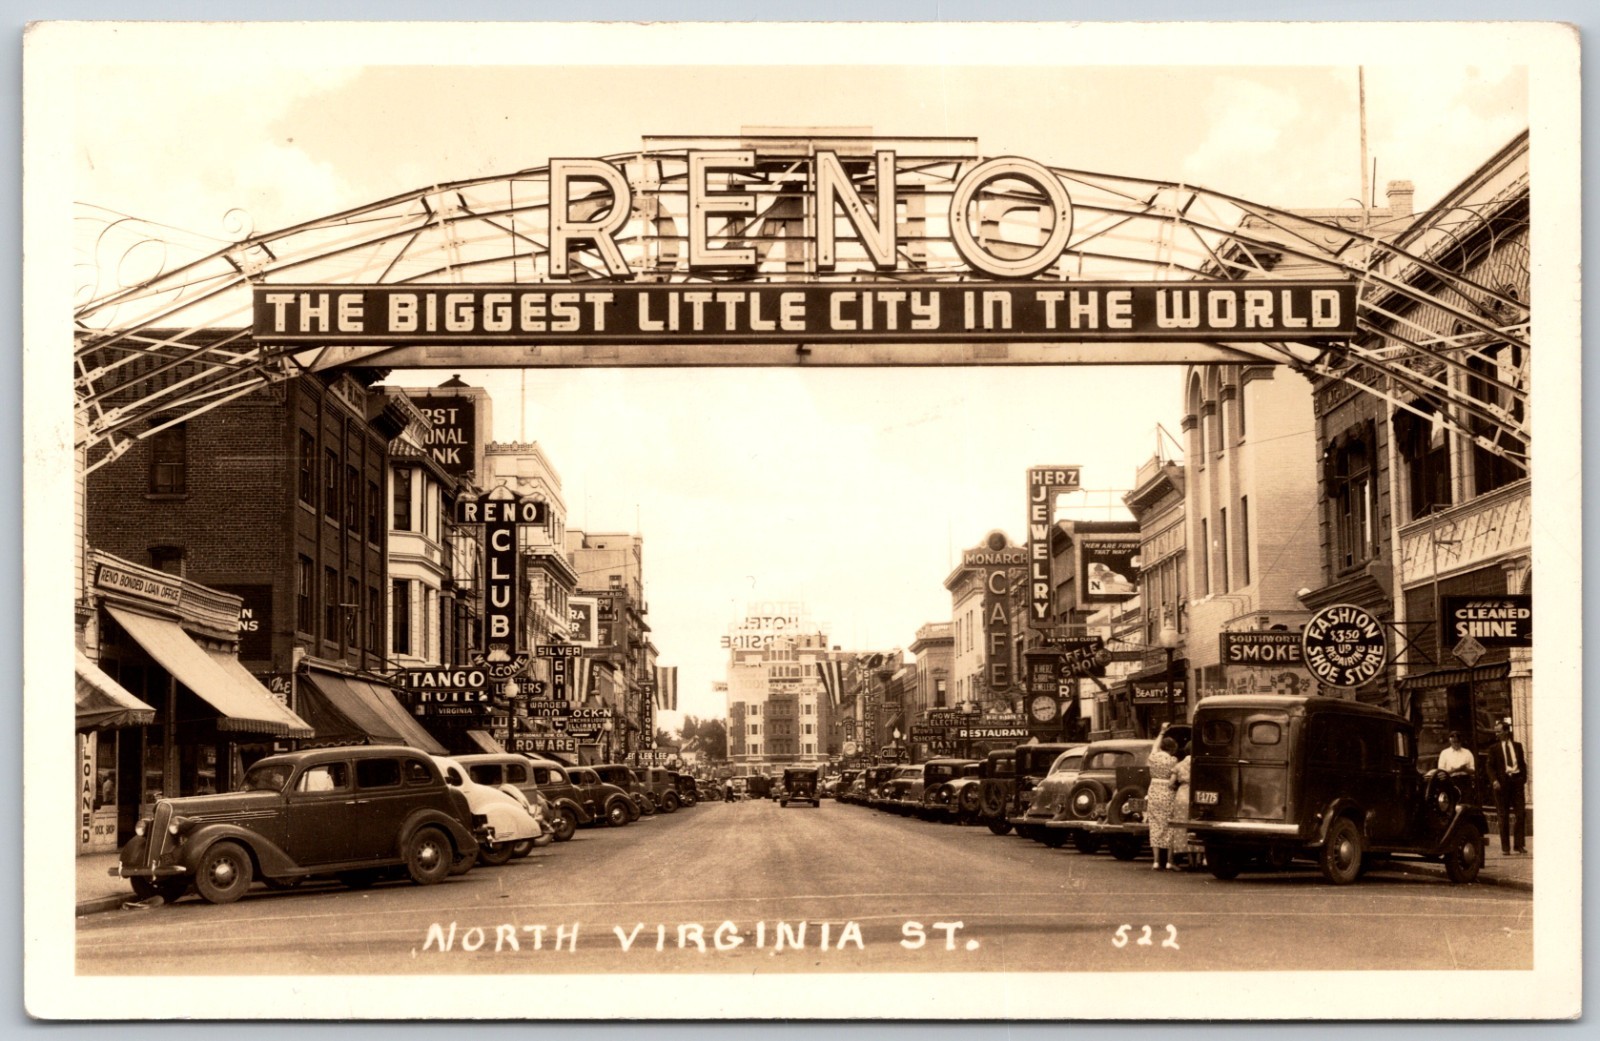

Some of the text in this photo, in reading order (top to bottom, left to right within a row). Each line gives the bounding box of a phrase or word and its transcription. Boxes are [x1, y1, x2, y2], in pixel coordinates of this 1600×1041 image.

[548, 149, 1073, 281] RENO
[266, 290, 1341, 332] THE BIGGEST LITTLE CITY IN THE WORLD
[420, 408, 459, 425] RST
[432, 447, 461, 464] NK
[1031, 471, 1078, 485] HERZ
[464, 502, 537, 522] RENO
[965, 553, 1028, 565] MONARCH
[1031, 486, 1049, 618] JEWELRY
[100, 570, 180, 602] RENO BONDED LOAN OFFICE
[491, 529, 510, 638] CLUB
[1455, 608, 1531, 619] CLEANED
[988, 570, 1008, 686] CAFE
[1309, 608, 1379, 641] FASHION
[1455, 621, 1517, 637] SHINE
[538, 647, 581, 656] SILVER
[1059, 643, 1099, 664] AFFLE
[1230, 644, 1300, 661] SMOKE
[1325, 645, 1366, 666] REPAIRING
[1338, 645, 1352, 654] UP
[1061, 656, 1097, 677] SHO
[1307, 645, 1383, 685] SHOE STORE
[409, 671, 485, 687] TANGO
[554, 660, 564, 727] GRIL
[1135, 686, 1182, 698] BEAUTY SOP
[530, 700, 567, 708] WANDER
[864, 670, 872, 753] STATIONERS
[960, 728, 1029, 738] RESTAURANT
[496, 739, 574, 752] HRDWARE
[931, 741, 957, 749] TAXI
[83, 747, 91, 843] LOANED
